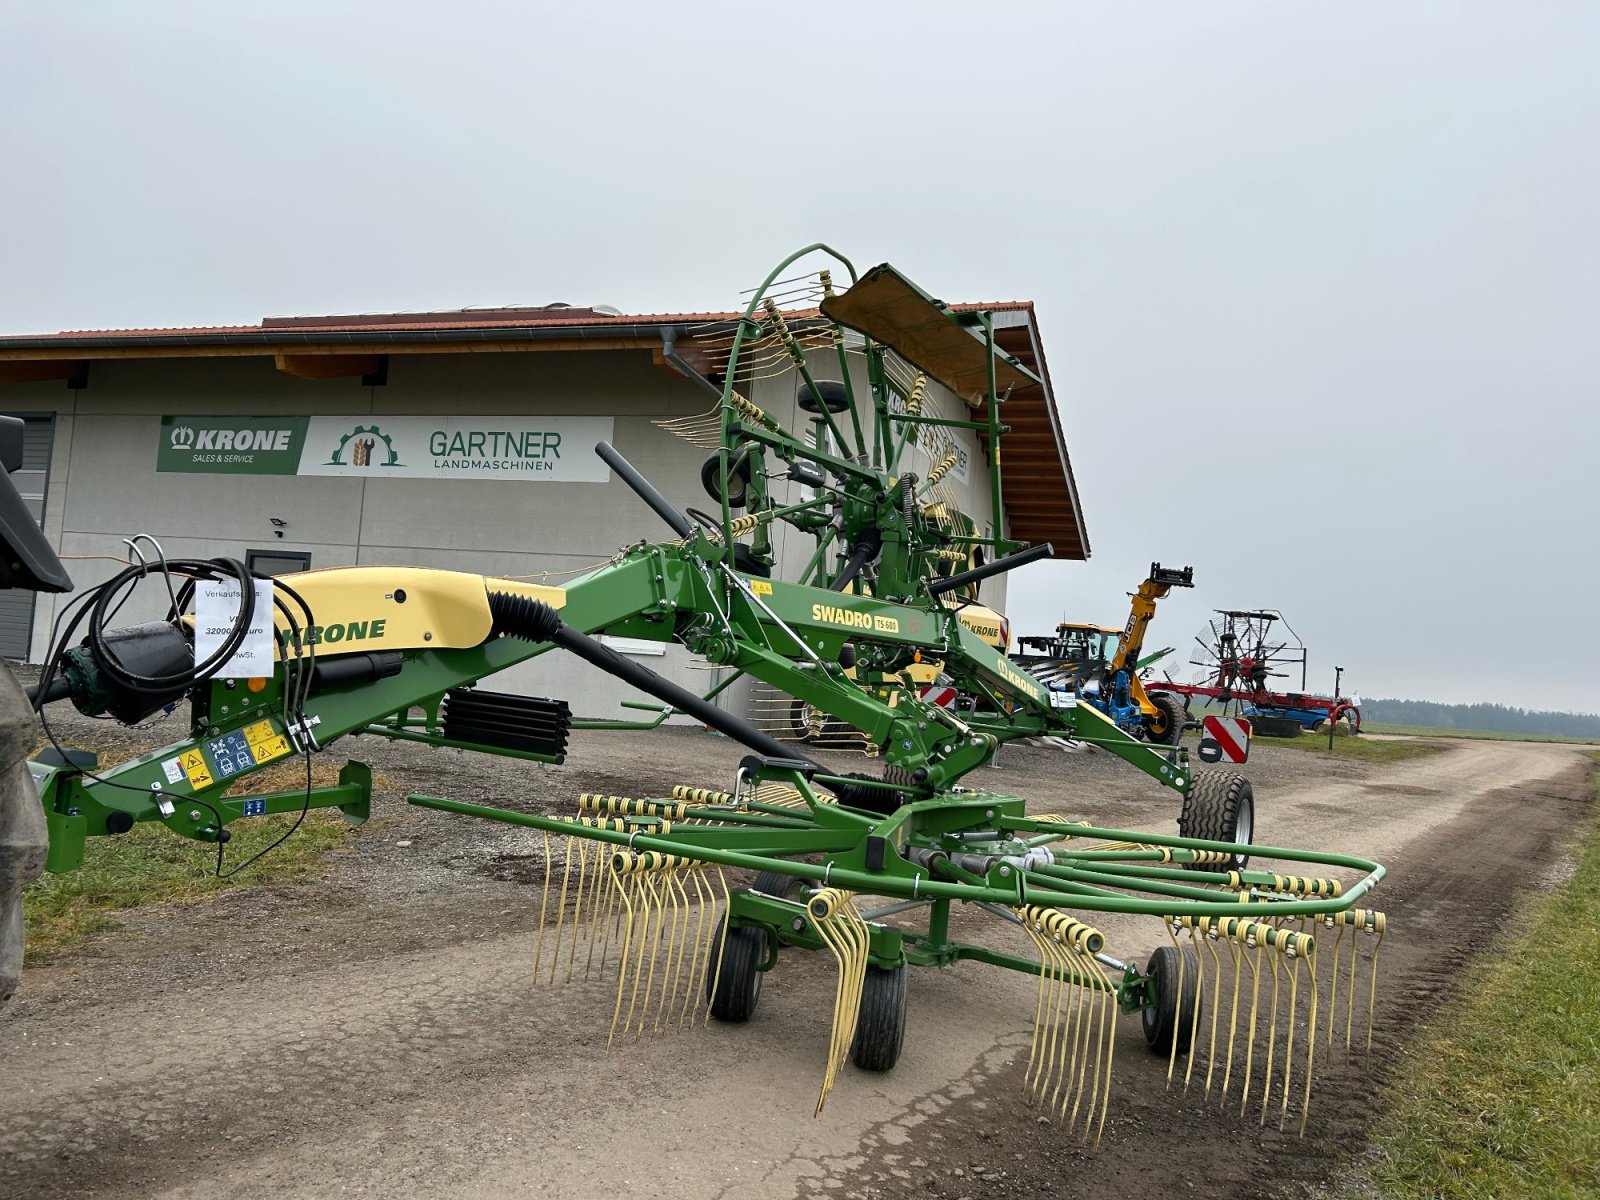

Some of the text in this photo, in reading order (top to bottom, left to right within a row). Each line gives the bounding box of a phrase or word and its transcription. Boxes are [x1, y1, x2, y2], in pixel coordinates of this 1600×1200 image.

[196, 430, 291, 451] KRONE
[429, 431, 561, 459] GARTNER
[192, 454, 254, 463] SALES & SERVICE
[434, 460, 554, 471] LANDMASCHINEN
[812, 603, 873, 630] SWADRO
[1125, 614, 1137, 643] JCB
[281, 619, 387, 649] KRONE
[970, 623, 999, 638] KRONE
[1008, 669, 1039, 700] KRONE
